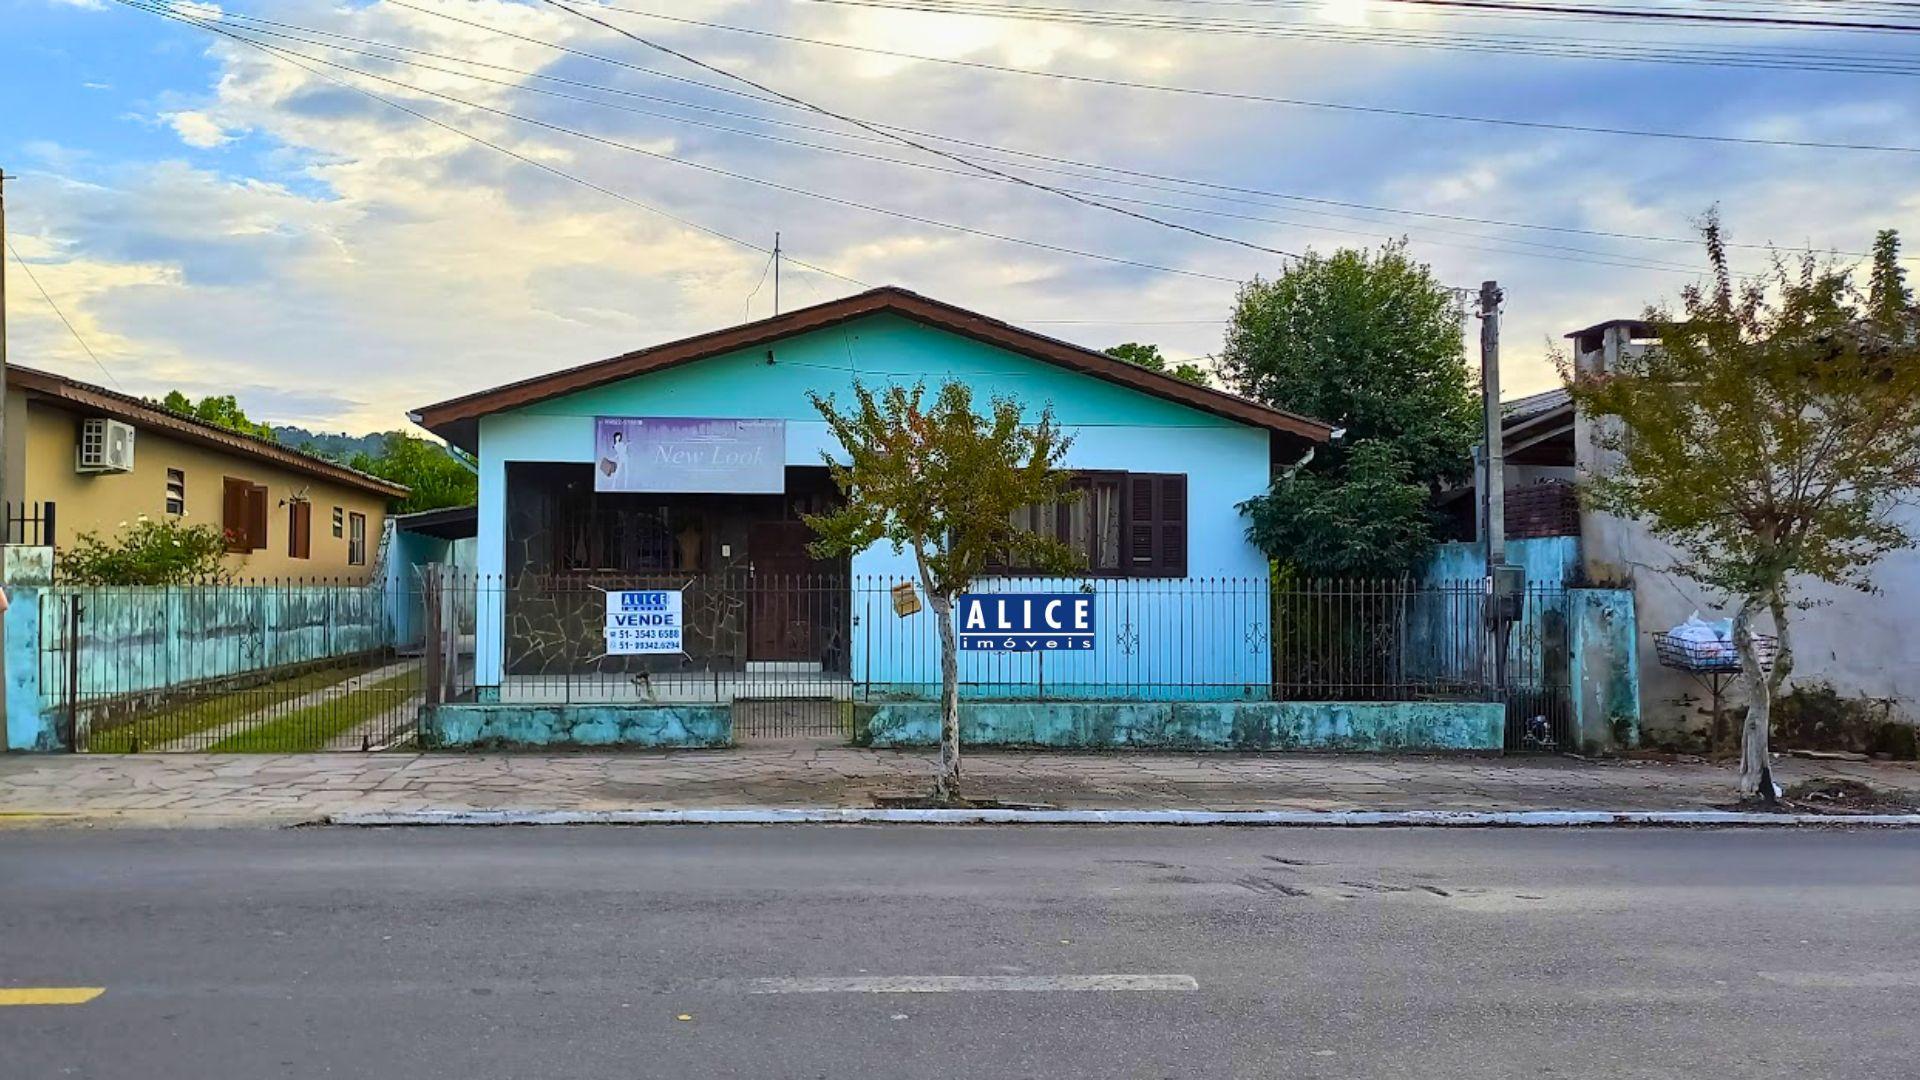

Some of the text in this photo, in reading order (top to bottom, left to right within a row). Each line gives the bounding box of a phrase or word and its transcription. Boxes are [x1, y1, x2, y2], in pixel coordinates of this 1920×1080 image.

[655, 445, 762, 465] New Look
[624, 594, 666, 605] ALICE
[615, 614, 674, 626] VENDE
